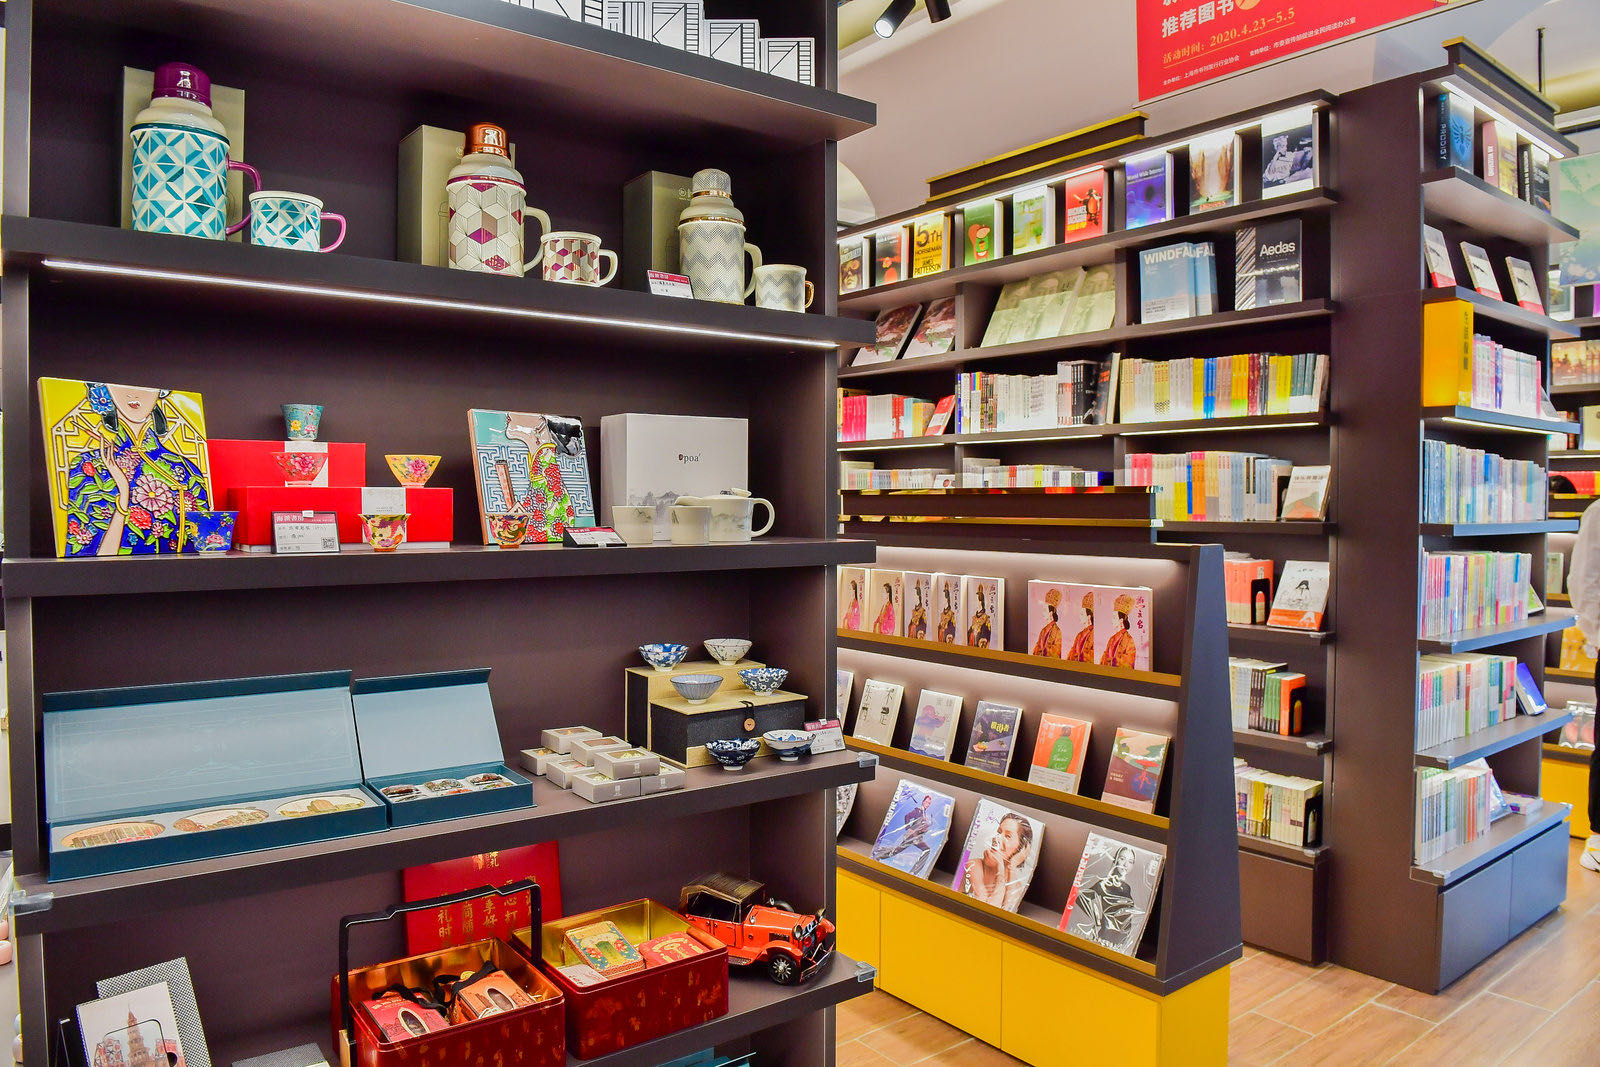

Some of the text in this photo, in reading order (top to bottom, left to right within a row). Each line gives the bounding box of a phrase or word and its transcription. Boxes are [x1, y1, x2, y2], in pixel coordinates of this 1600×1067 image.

[1161, 0, 1235, 38] 推荐图书
[915, 245, 942, 255] HORSEMAN
[1259, 241, 1296, 258] Aedas
[914, 263, 943, 275] PATTERSON
